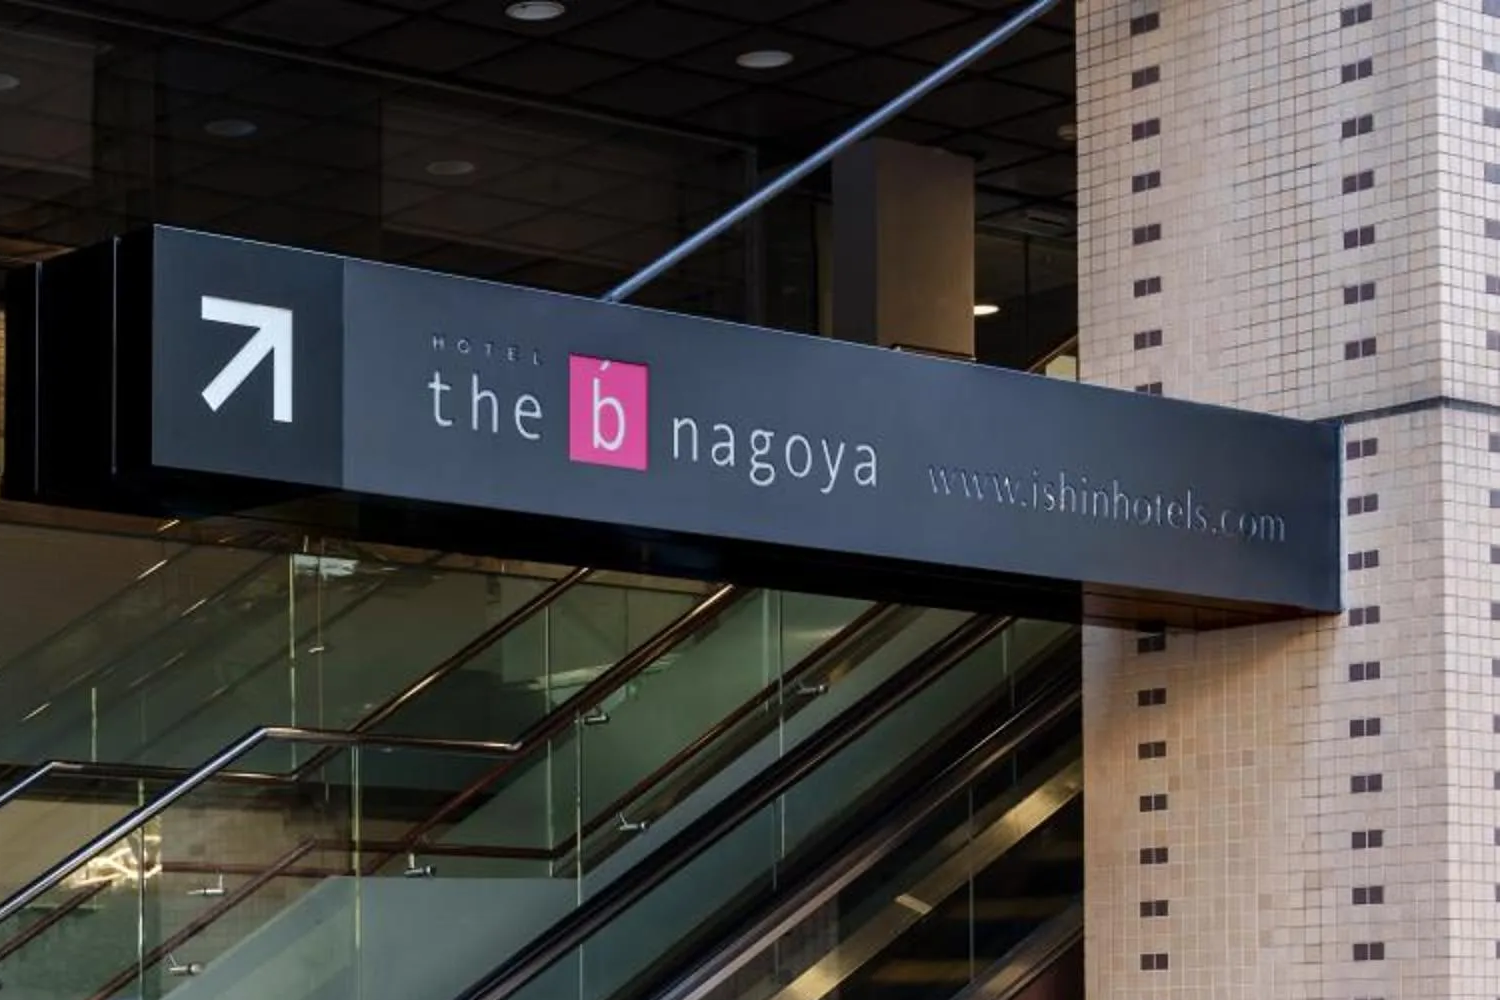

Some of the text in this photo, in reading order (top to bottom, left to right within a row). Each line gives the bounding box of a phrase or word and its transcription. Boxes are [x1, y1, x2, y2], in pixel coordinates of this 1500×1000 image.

[431, 334, 543, 367] HOTEL
[427, 370, 543, 440] the
[672, 416, 877, 494] nagoya
[927, 463, 1287, 543] www.ishinhotels.com
